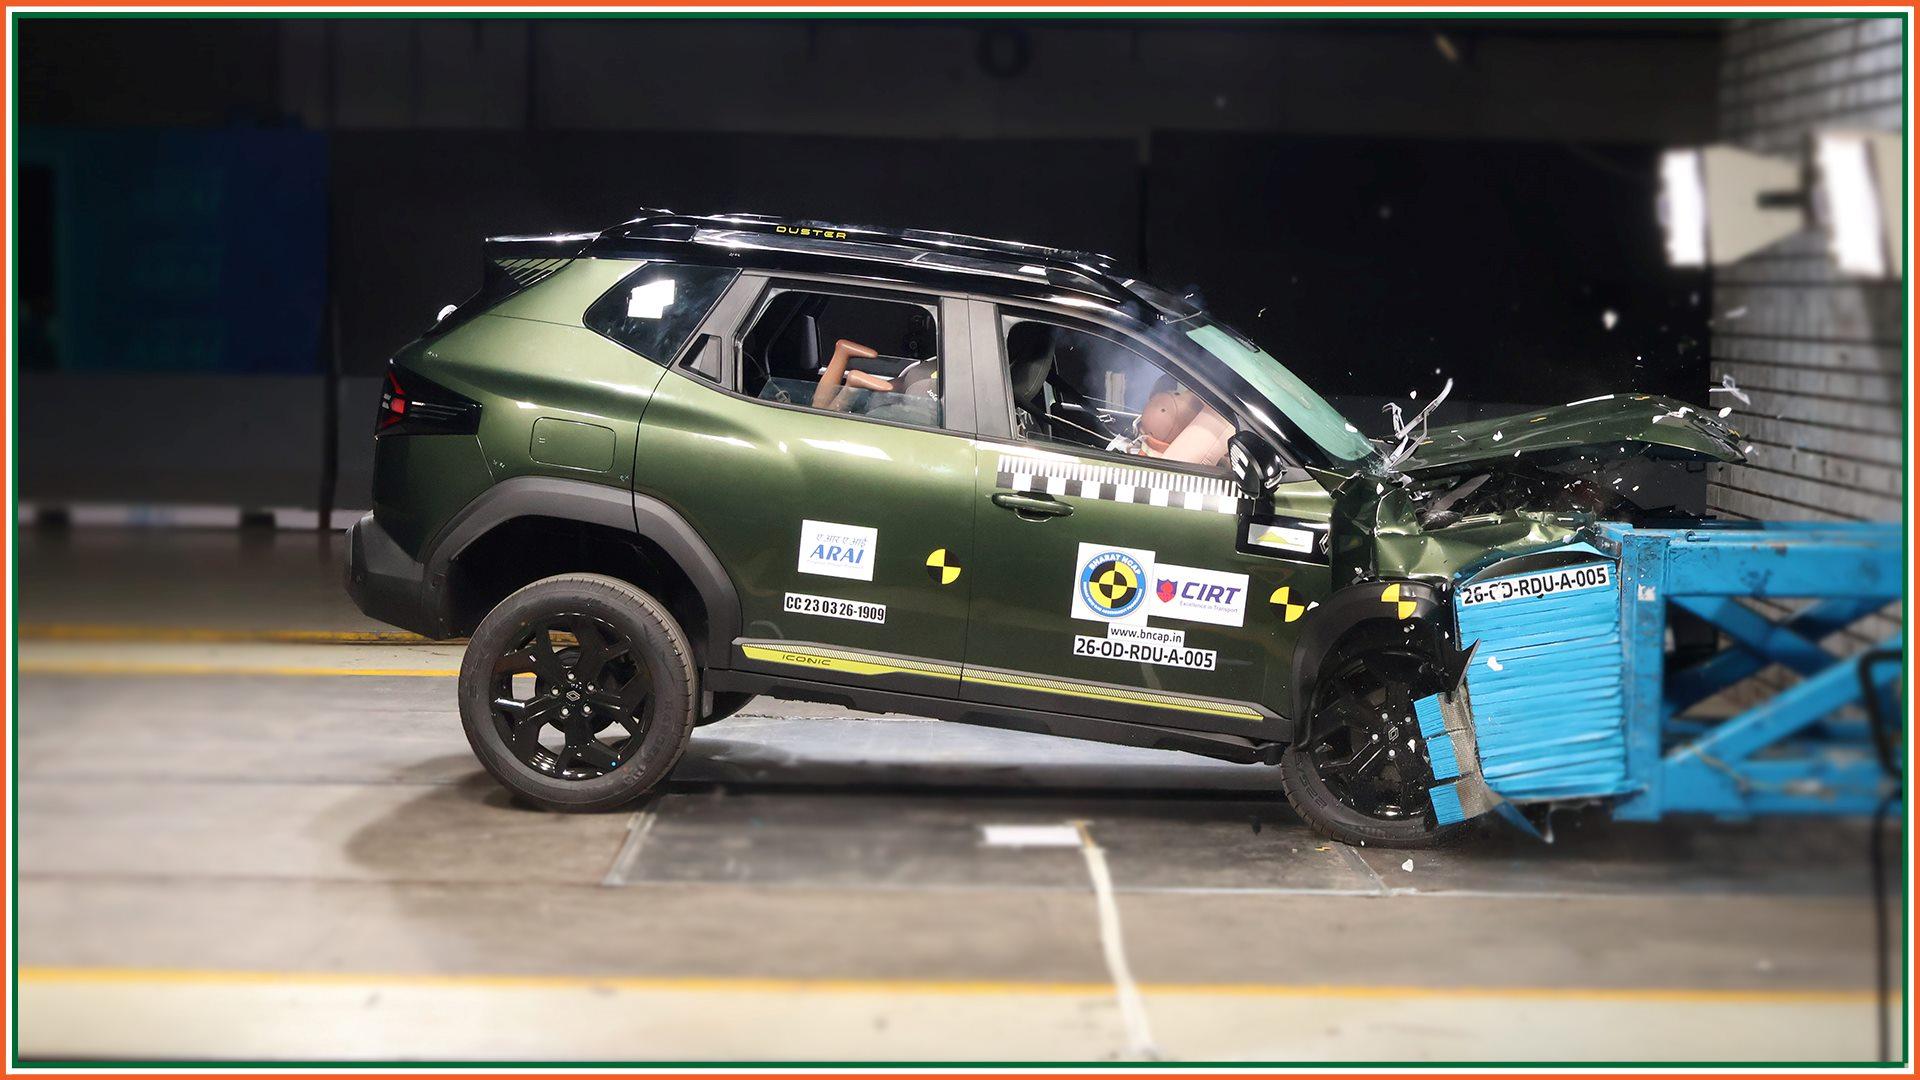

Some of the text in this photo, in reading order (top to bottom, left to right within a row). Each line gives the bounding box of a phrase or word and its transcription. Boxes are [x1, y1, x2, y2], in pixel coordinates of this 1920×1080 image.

[776, 226, 846, 239] DUSTER
[810, 544, 864, 564] ARAI
[1088, 553, 1141, 575] BHARAT NCAP
[1181, 581, 1241, 605] CIRT
[787, 596, 885, 621] CC 23 03 26-1909
[1213, 604, 1238, 614] Transport
[1110, 627, 1182, 644] www.bncap.in
[782, 654, 832, 666] ICONIC
[1075, 638, 1214, 668] 26-OD-RDU-A-005
